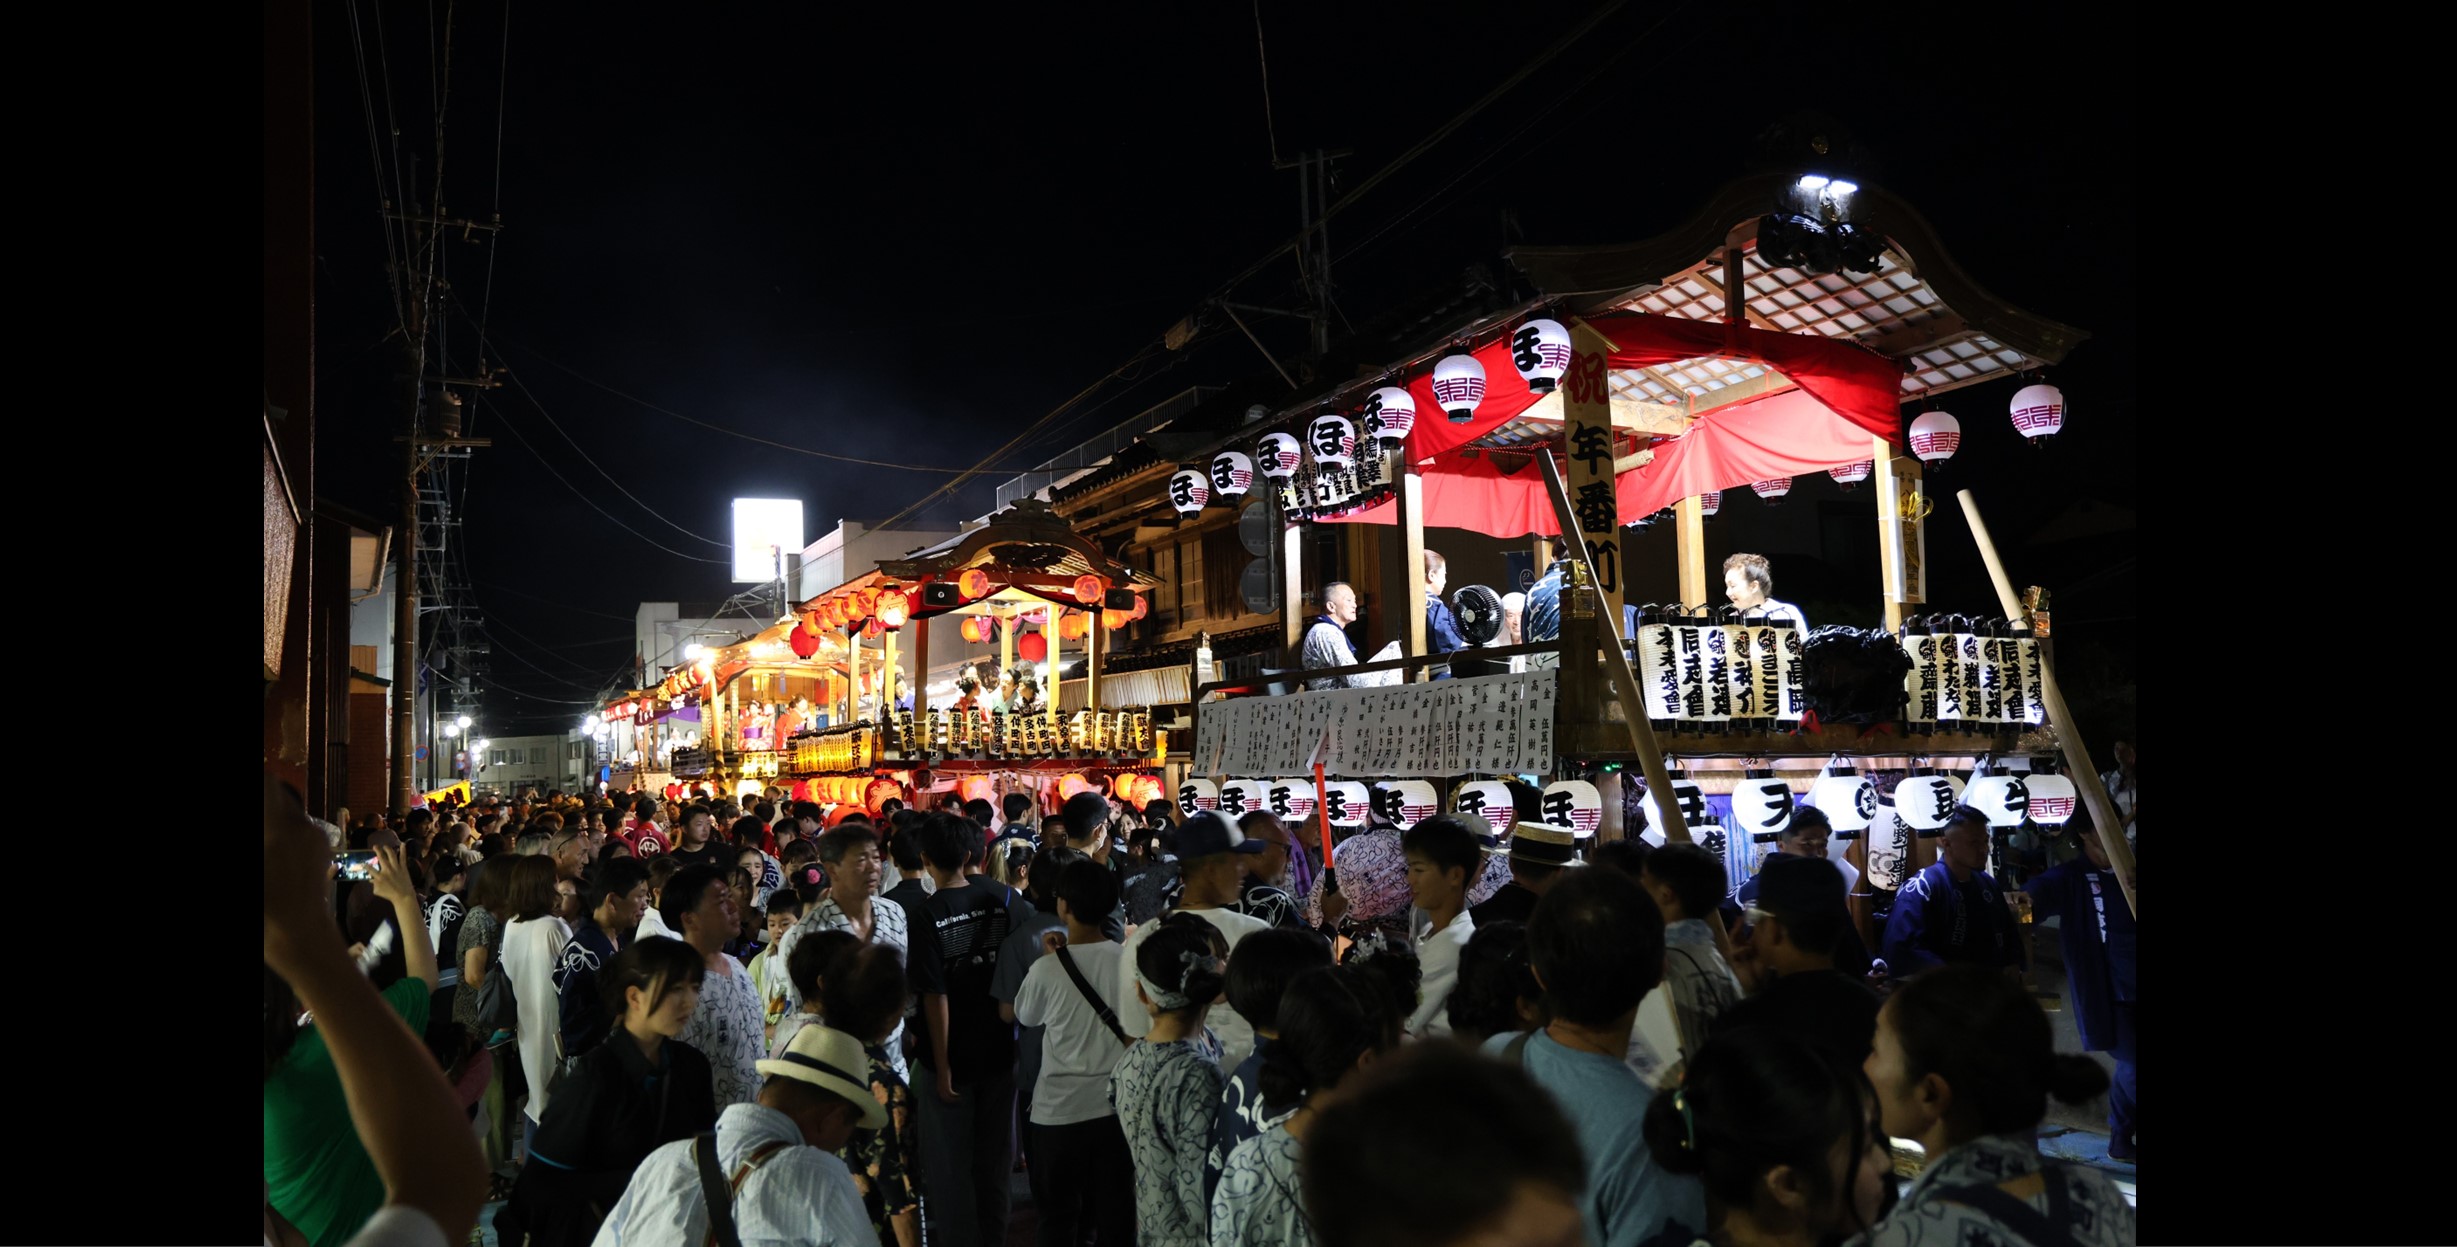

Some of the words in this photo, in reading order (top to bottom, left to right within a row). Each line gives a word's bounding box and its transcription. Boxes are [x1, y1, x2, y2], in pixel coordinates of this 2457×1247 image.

[1309, 421, 1346, 456] ほ
[1024, 718, 1037, 751] 多古町
